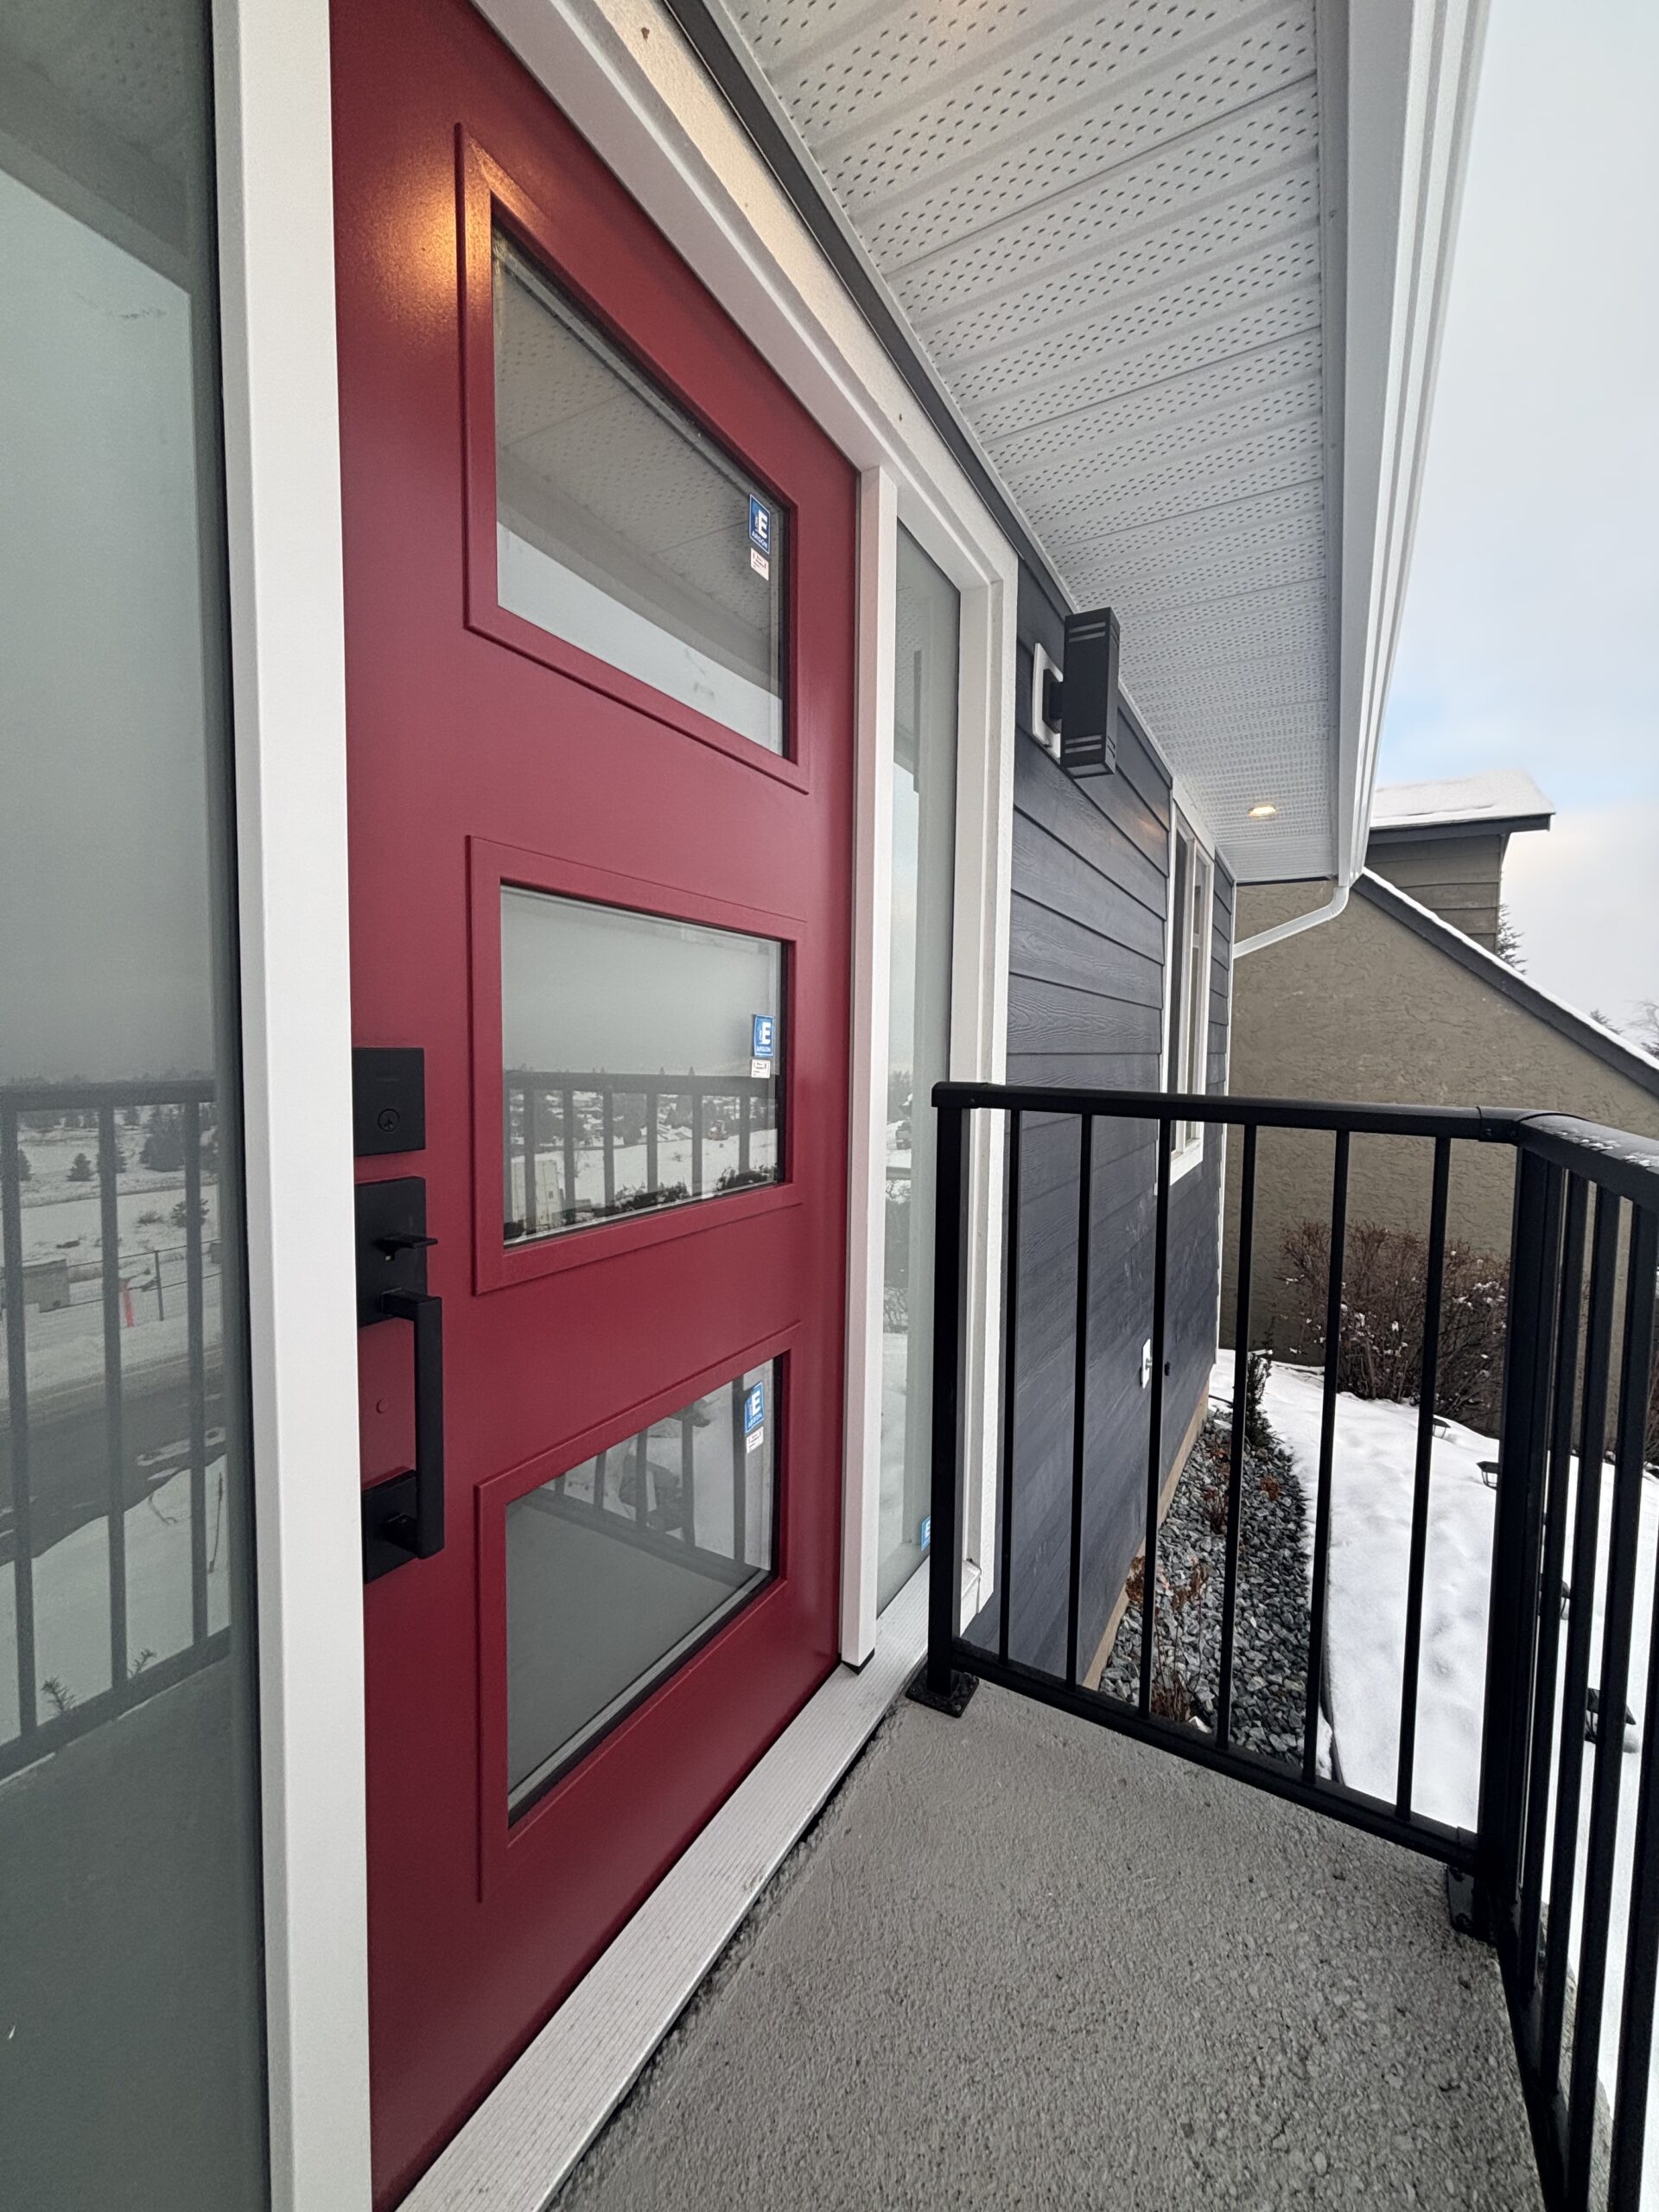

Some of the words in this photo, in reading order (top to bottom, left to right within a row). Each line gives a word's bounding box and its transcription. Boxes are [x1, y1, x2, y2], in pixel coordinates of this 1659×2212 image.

[758, 509, 768, 539] E
[762, 1021, 772, 1045] E
[751, 1390, 761, 1417] E
